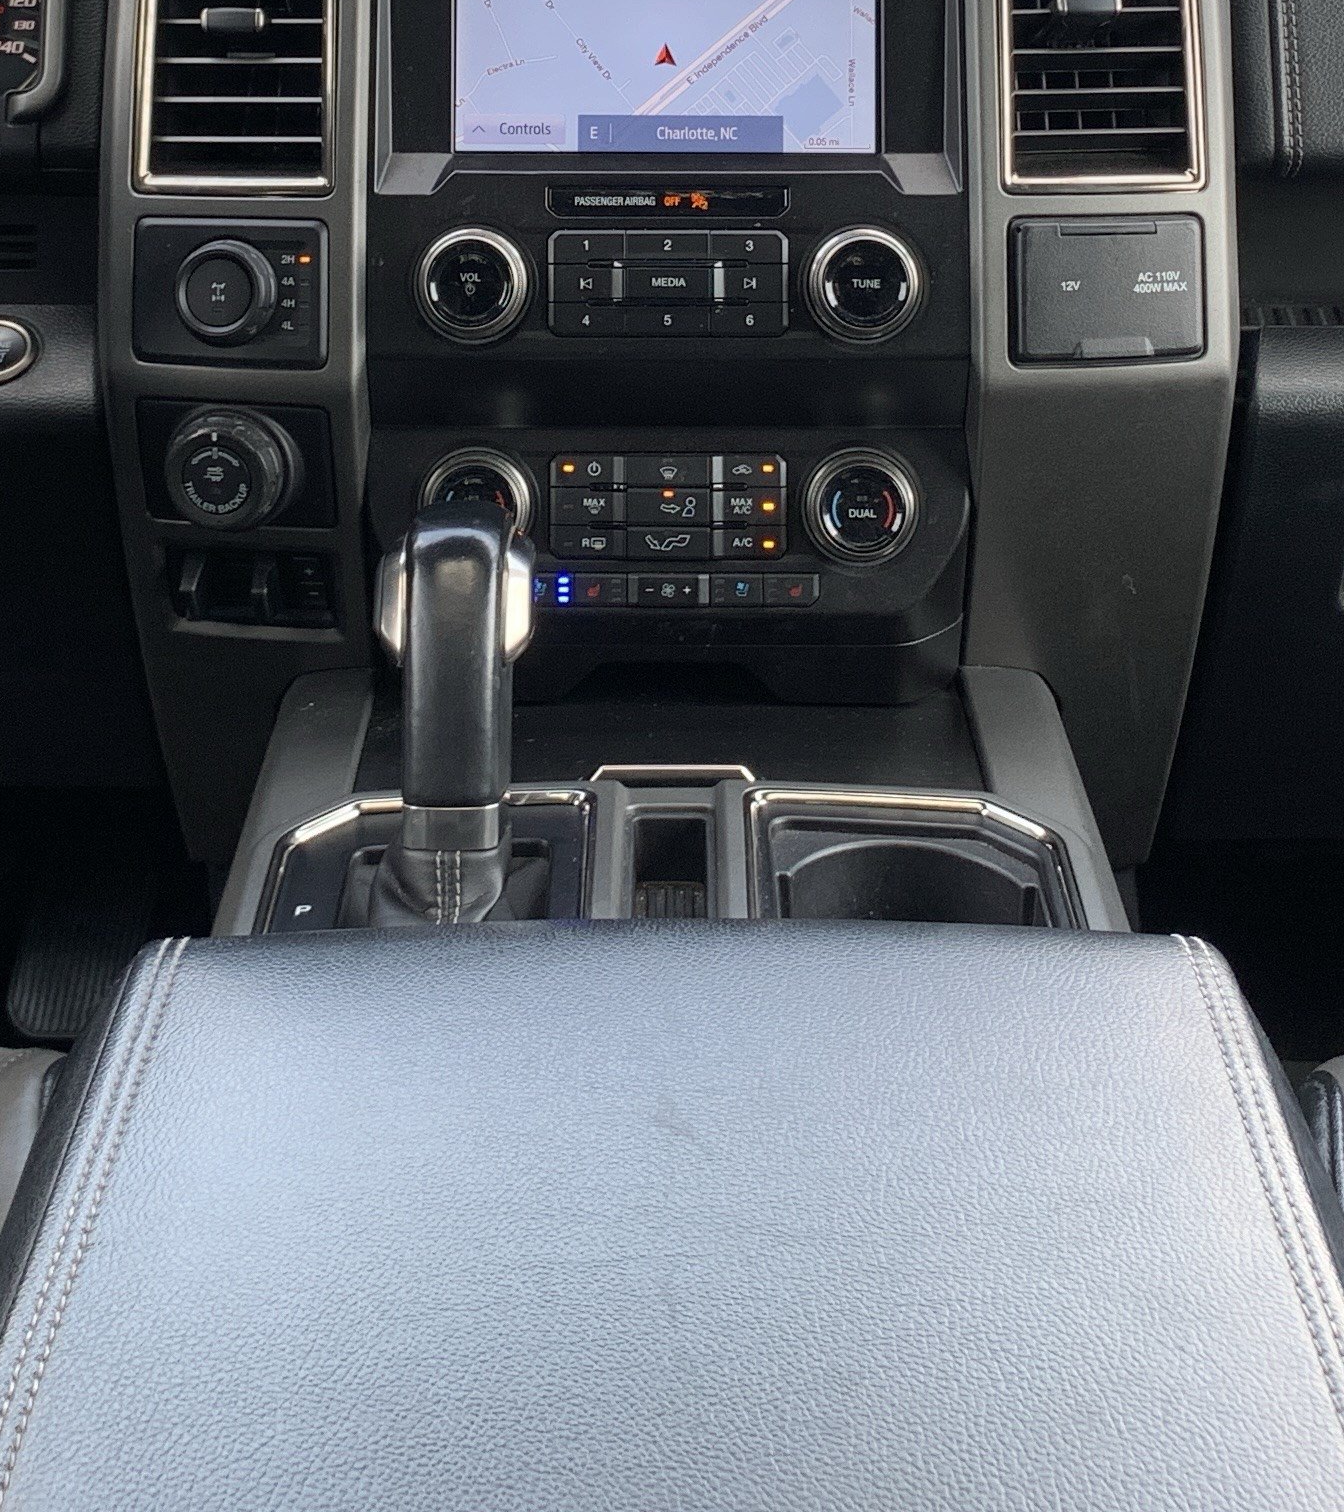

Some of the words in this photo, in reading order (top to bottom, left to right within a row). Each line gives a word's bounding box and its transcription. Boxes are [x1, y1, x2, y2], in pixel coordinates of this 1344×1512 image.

[13, 19, 36, 30] 130
[686, 75, 695, 85] E
[694, 30, 750, 80] Independence
[748, 14, 769, 34] Blvd
[576, 38, 590, 54] City
[588, 52, 604, 72] View
[602, 70, 612, 81] Dr
[486, 62, 514, 76] Electra
[848, 58, 857, 94] Wallace
[848, 95, 856, 107] Ln
[499, 122, 551, 135] Controls
[590, 126, 598, 139] E
[657, 125, 718, 142] Charlotte,
[720, 126, 739, 140] NC
[808, 137, 827, 147] 0.05
[574, 196, 624, 206] PASSENGER
[624, 196, 656, 206] AIRBAG
[663, 196, 681, 207] OFF
[582, 240, 589, 251] 1
[663, 239, 672, 251] 2
[745, 240, 754, 251] 3
[281, 254, 295, 264] 2H
[281, 276, 295, 286] 4A
[460, 273, 481, 283] VOL
[1138, 272, 1154, 282] AC
[1156, 271, 1180, 281] 110V
[651, 277, 686, 288] MEDIA
[852, 278, 881, 289] TUNE
[1060, 281, 1081, 291] 12V
[1133, 282, 1162, 294] 400W
[1163, 281, 1188, 292] MAX
[281, 298, 295, 308] 4H
[281, 320, 294, 330] 4L
[582, 314, 590, 326] 4
[663, 314, 672, 326] 5
[745, 314, 754, 326] 6
[183, 480, 216, 514] TRAILER
[217, 482, 248, 514] BACKUP
[583, 498, 606, 507] MAX
[730, 497, 753, 507] MAX
[733, 506, 752, 515] A/C
[848, 508, 877, 519] DUAL
[732, 538, 753, 548] A/C
[294, 904, 312, 916] P
